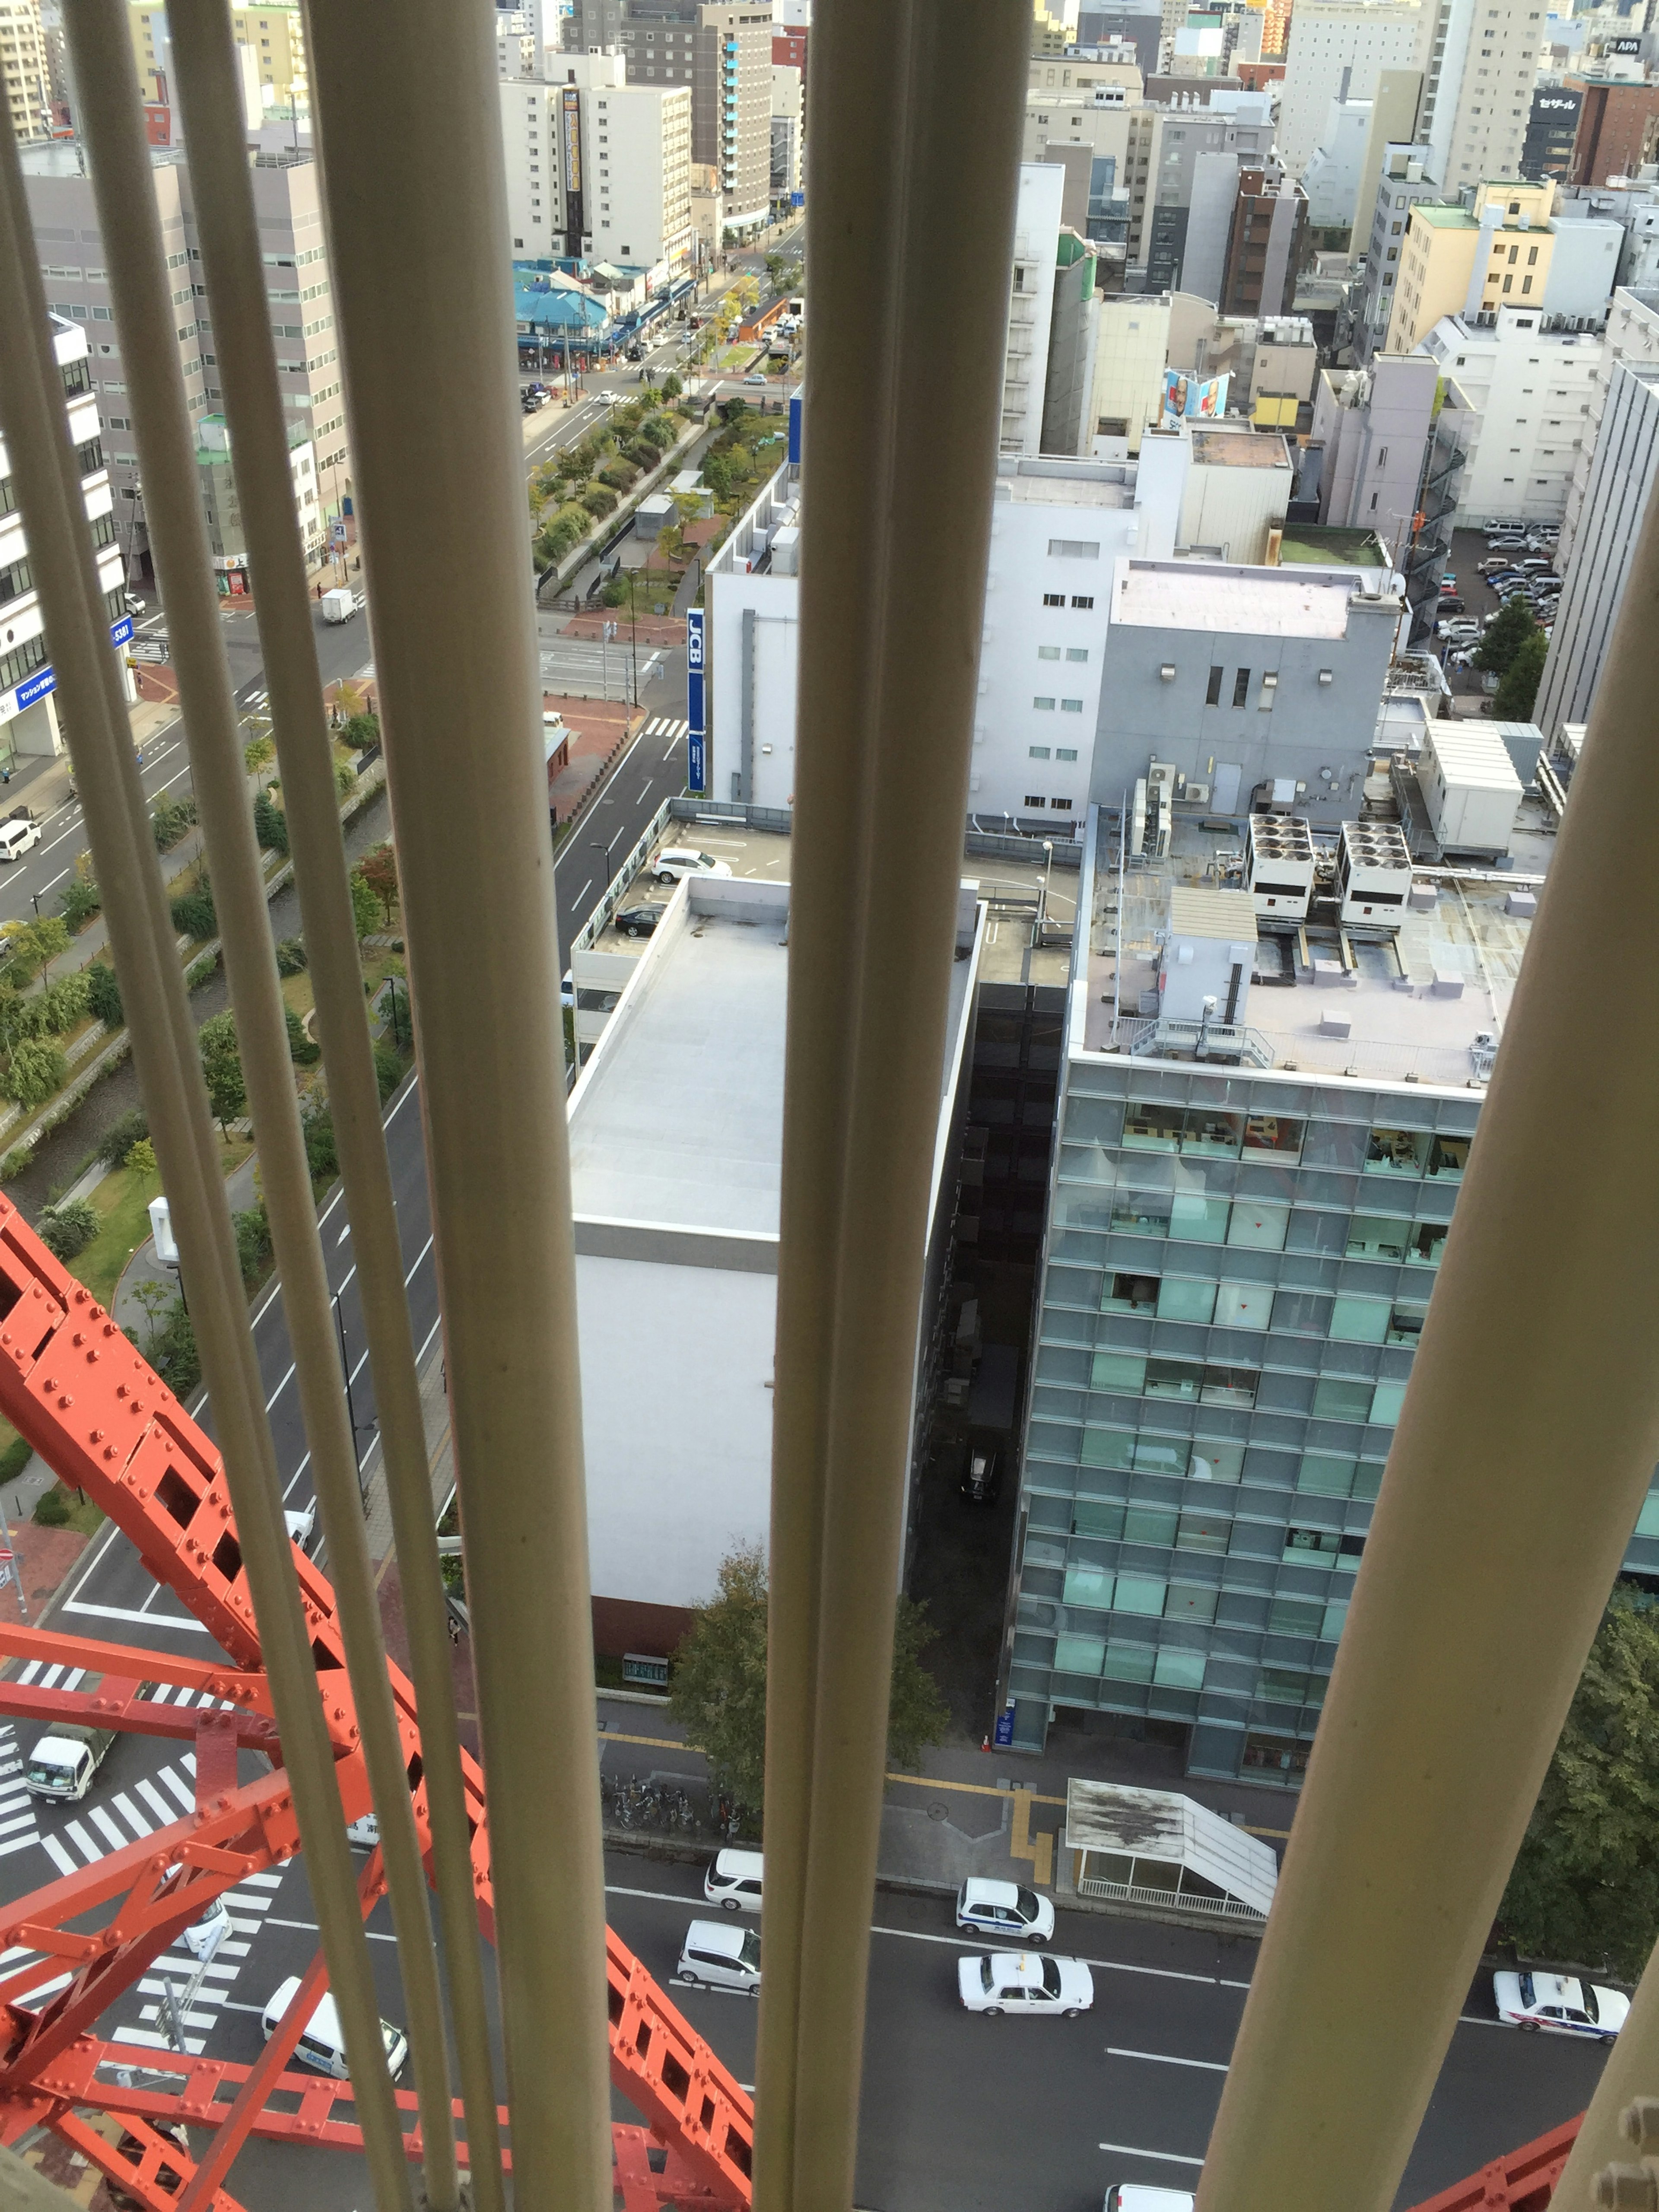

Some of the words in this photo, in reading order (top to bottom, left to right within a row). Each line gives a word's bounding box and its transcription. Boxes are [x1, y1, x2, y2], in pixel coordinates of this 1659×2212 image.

[1618, 41, 1637, 51] APA
[1540, 98, 1576, 109] セザール
[690, 619, 702, 663] JCB
